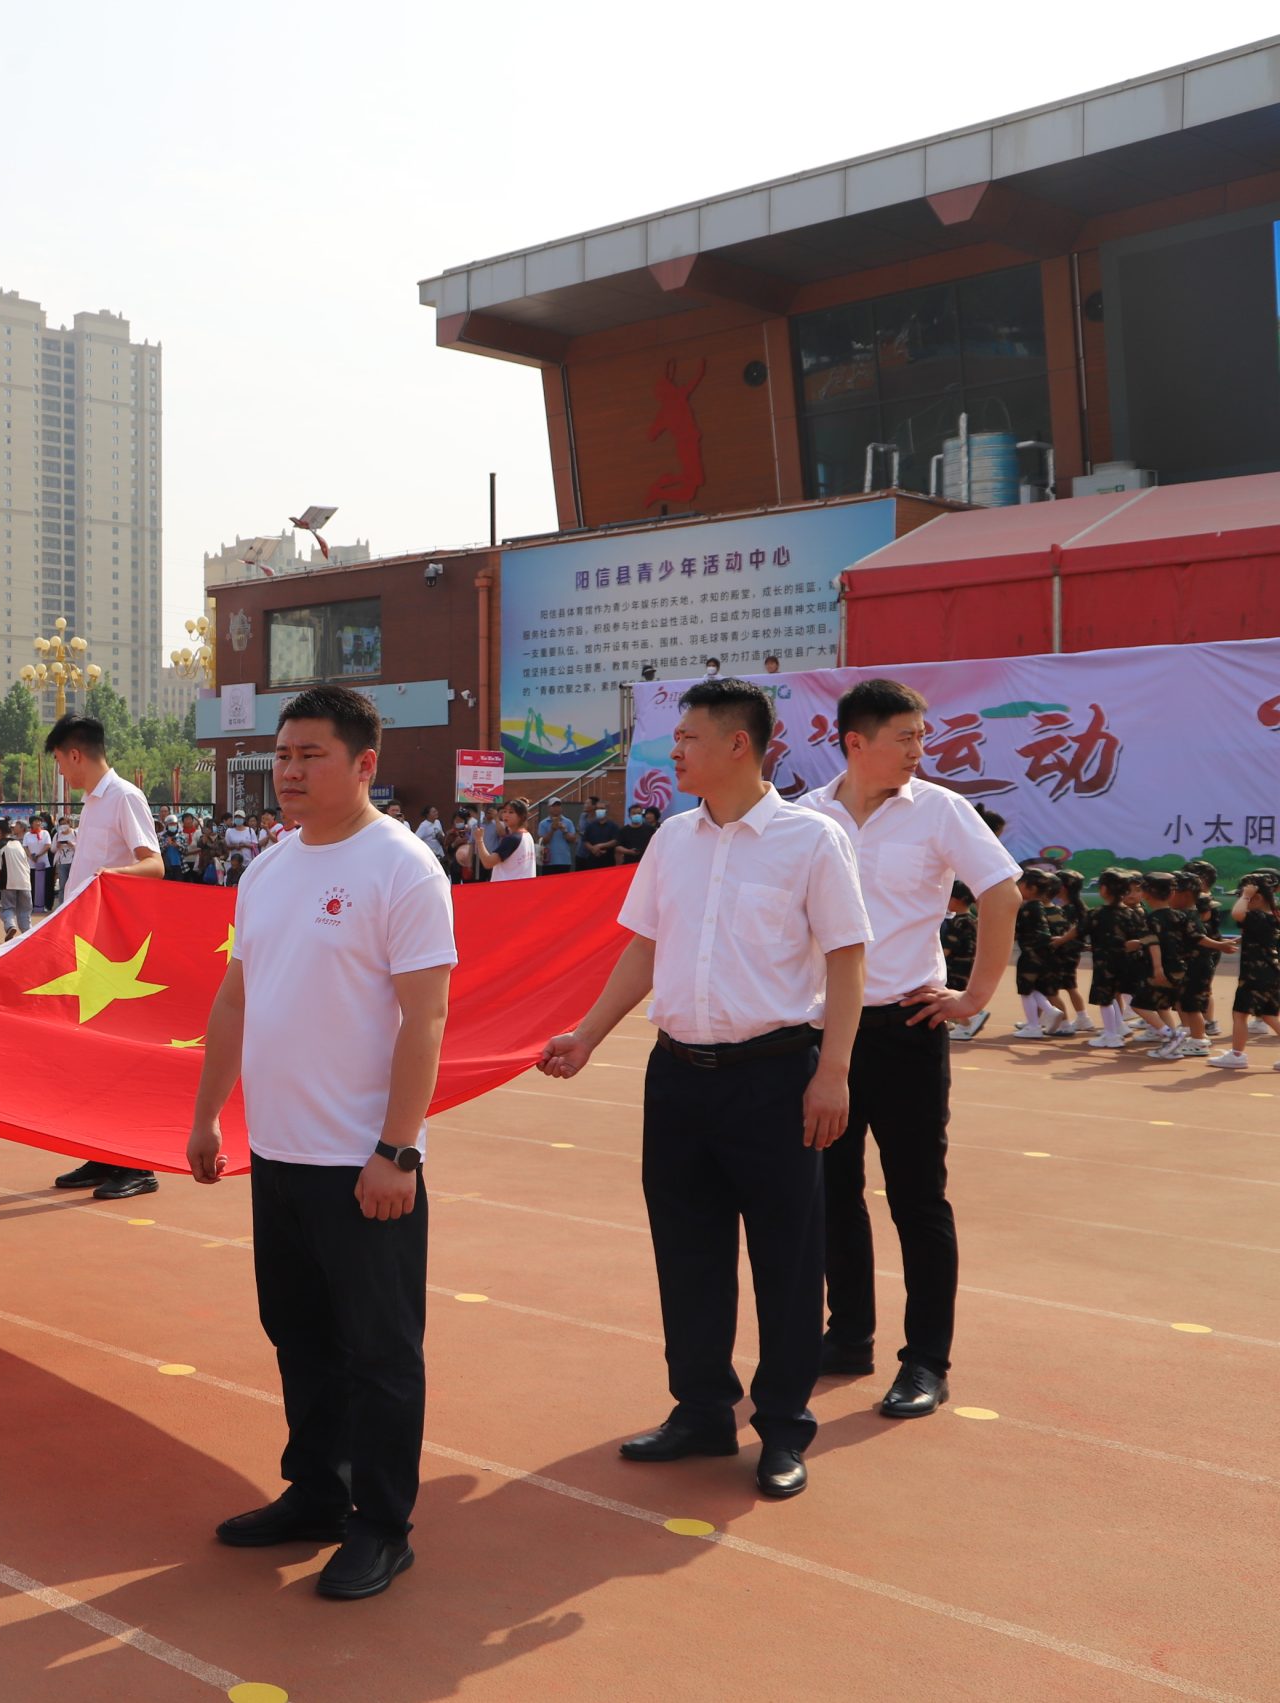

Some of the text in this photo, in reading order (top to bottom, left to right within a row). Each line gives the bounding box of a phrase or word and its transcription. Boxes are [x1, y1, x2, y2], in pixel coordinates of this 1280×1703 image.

[576, 545, 792, 591] 阳信县青少年活动中心
[1163, 813, 1276, 846] 小太阳
